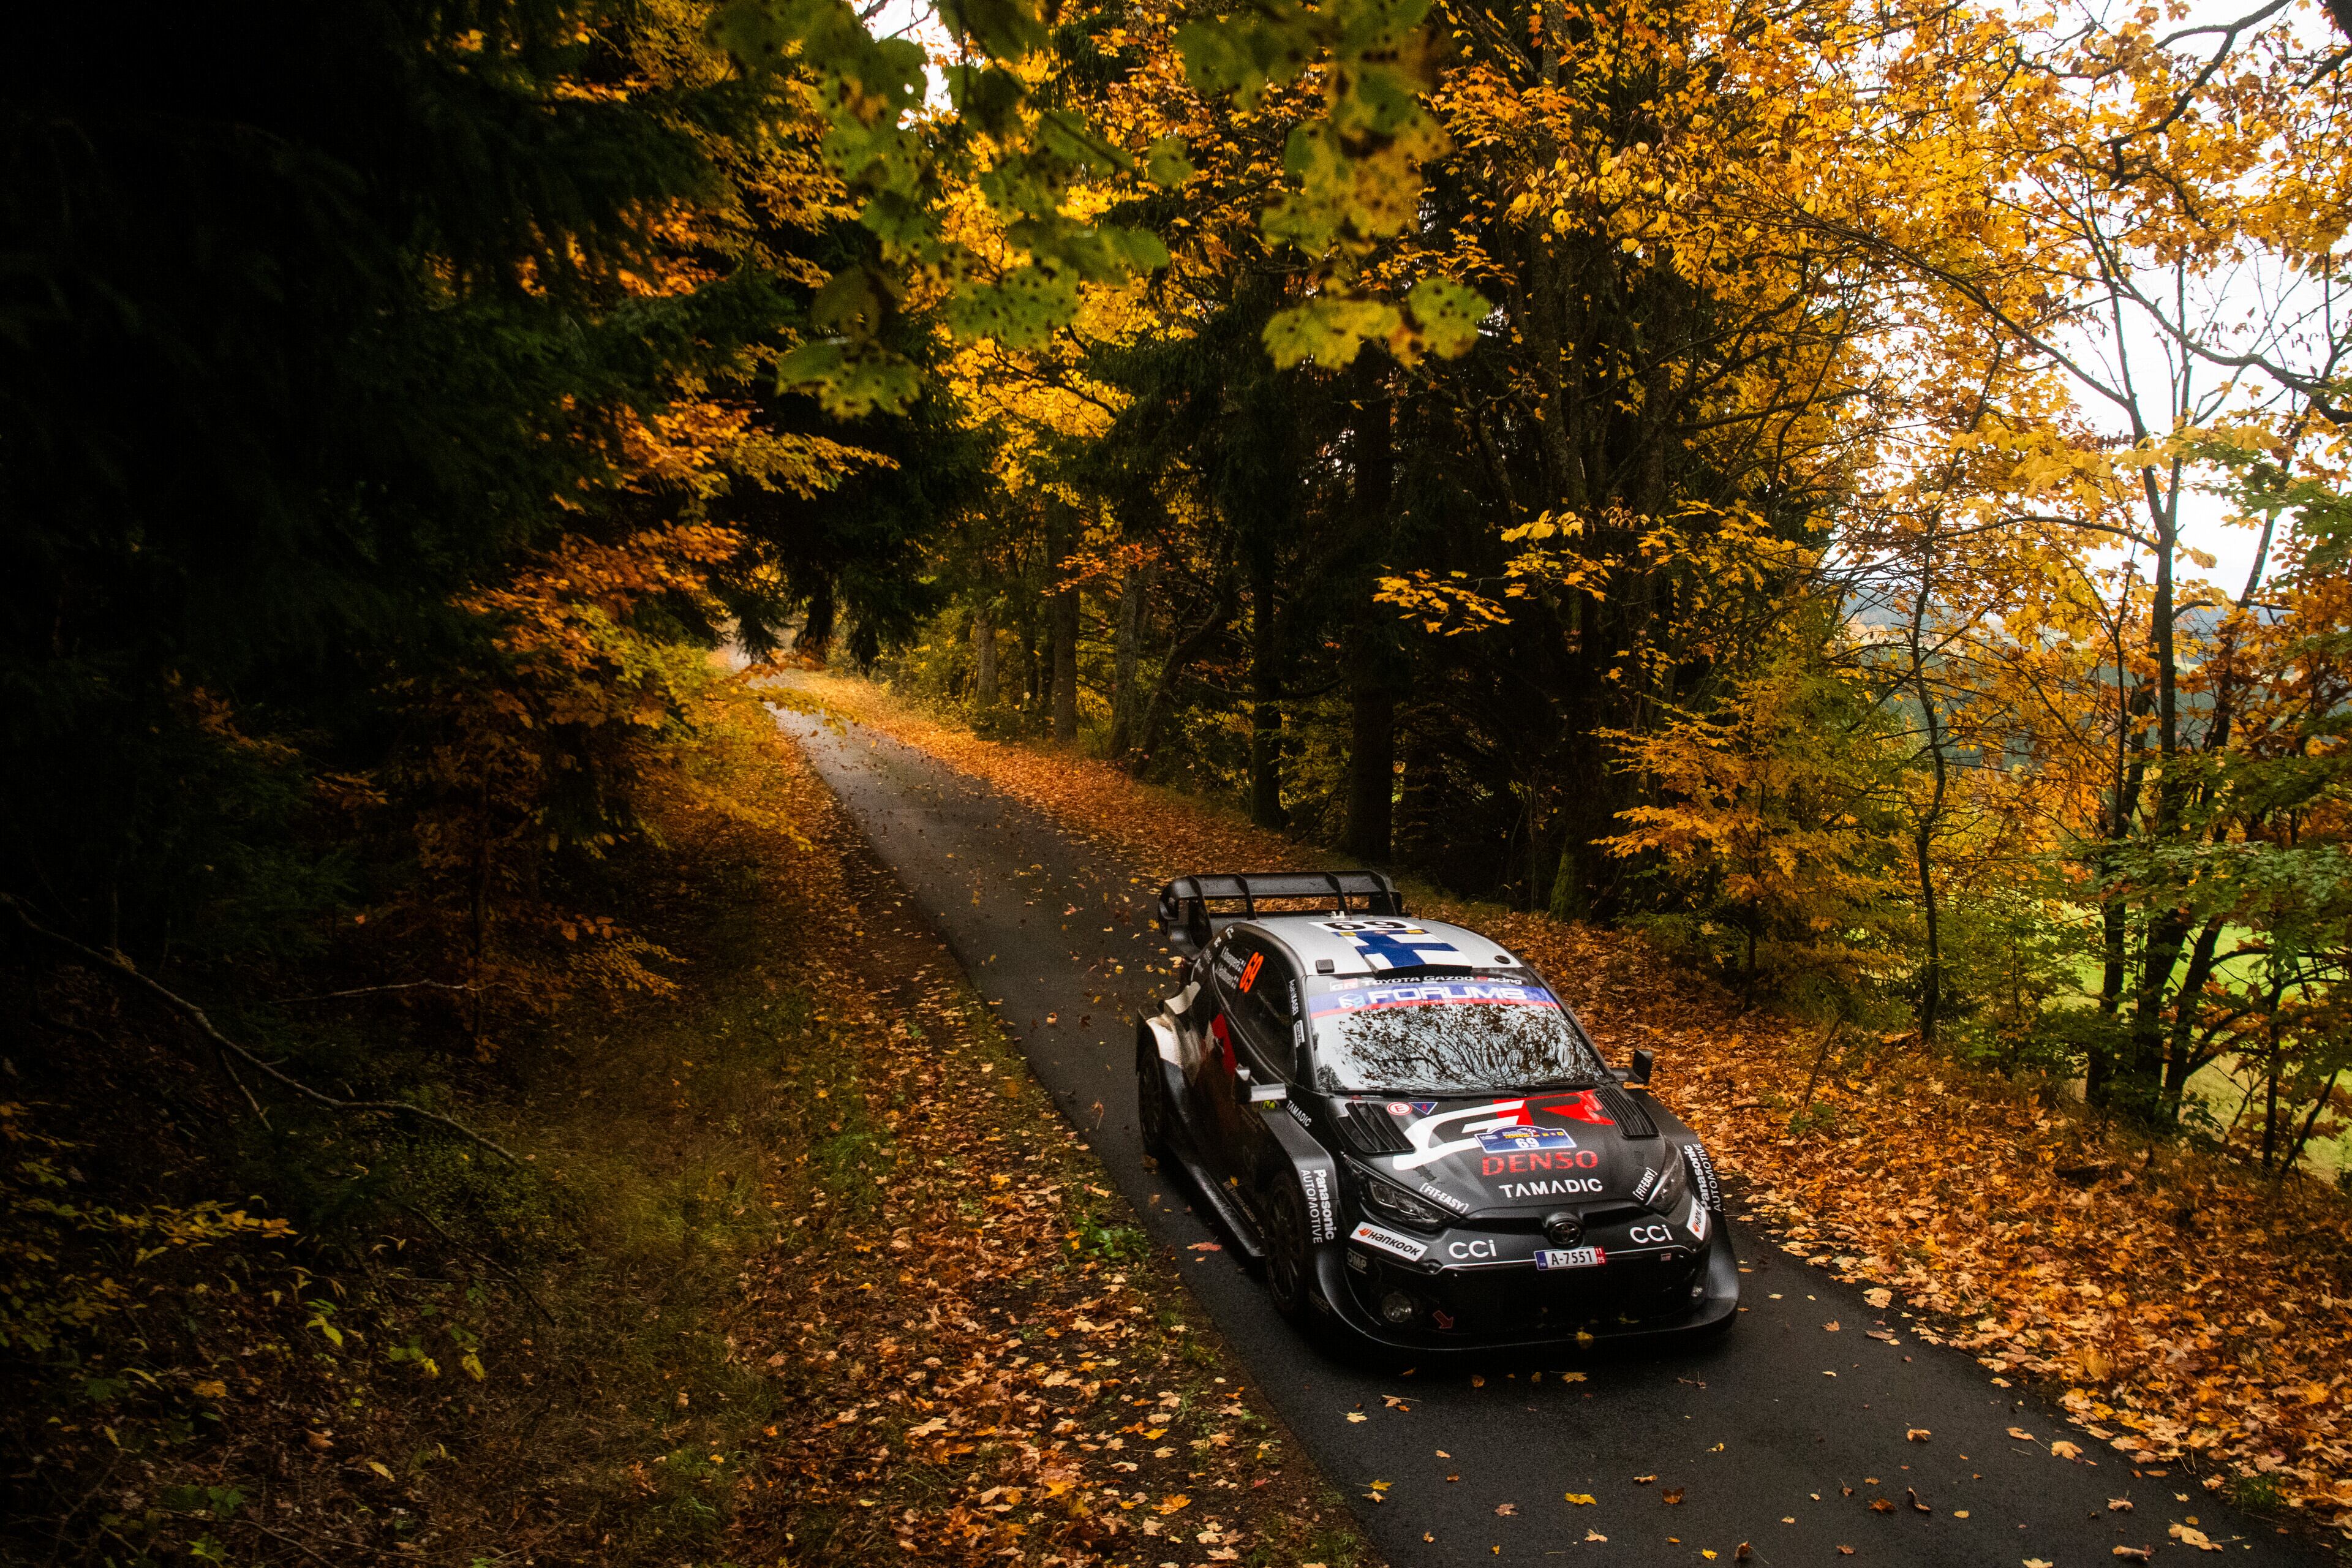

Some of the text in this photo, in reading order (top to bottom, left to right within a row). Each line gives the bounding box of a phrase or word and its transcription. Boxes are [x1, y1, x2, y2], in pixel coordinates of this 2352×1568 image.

[1324, 921, 1407, 930] 69
[1239, 951, 1264, 993] 69
[1362, 976, 1420, 987] TOYOTA
[1477, 976, 1523, 985] Racing
[1367, 986, 1527, 1004] FORUM8
[1286, 1100, 1312, 1127] TAMADIC
[1515, 1137, 1540, 1148] 69
[1482, 1150, 1599, 1177] DENSO
[1499, 1178, 1603, 1198] TAMADIC
[1684, 1144, 1713, 1211] Panasonic
[1691, 1143, 1724, 1213] AUTOMOTIVE
[1300, 1169, 1323, 1244] AUTOMOTIVE
[1314, 1169, 1335, 1240] Panasonic
[1551, 1251, 1593, 1265] A-7551
